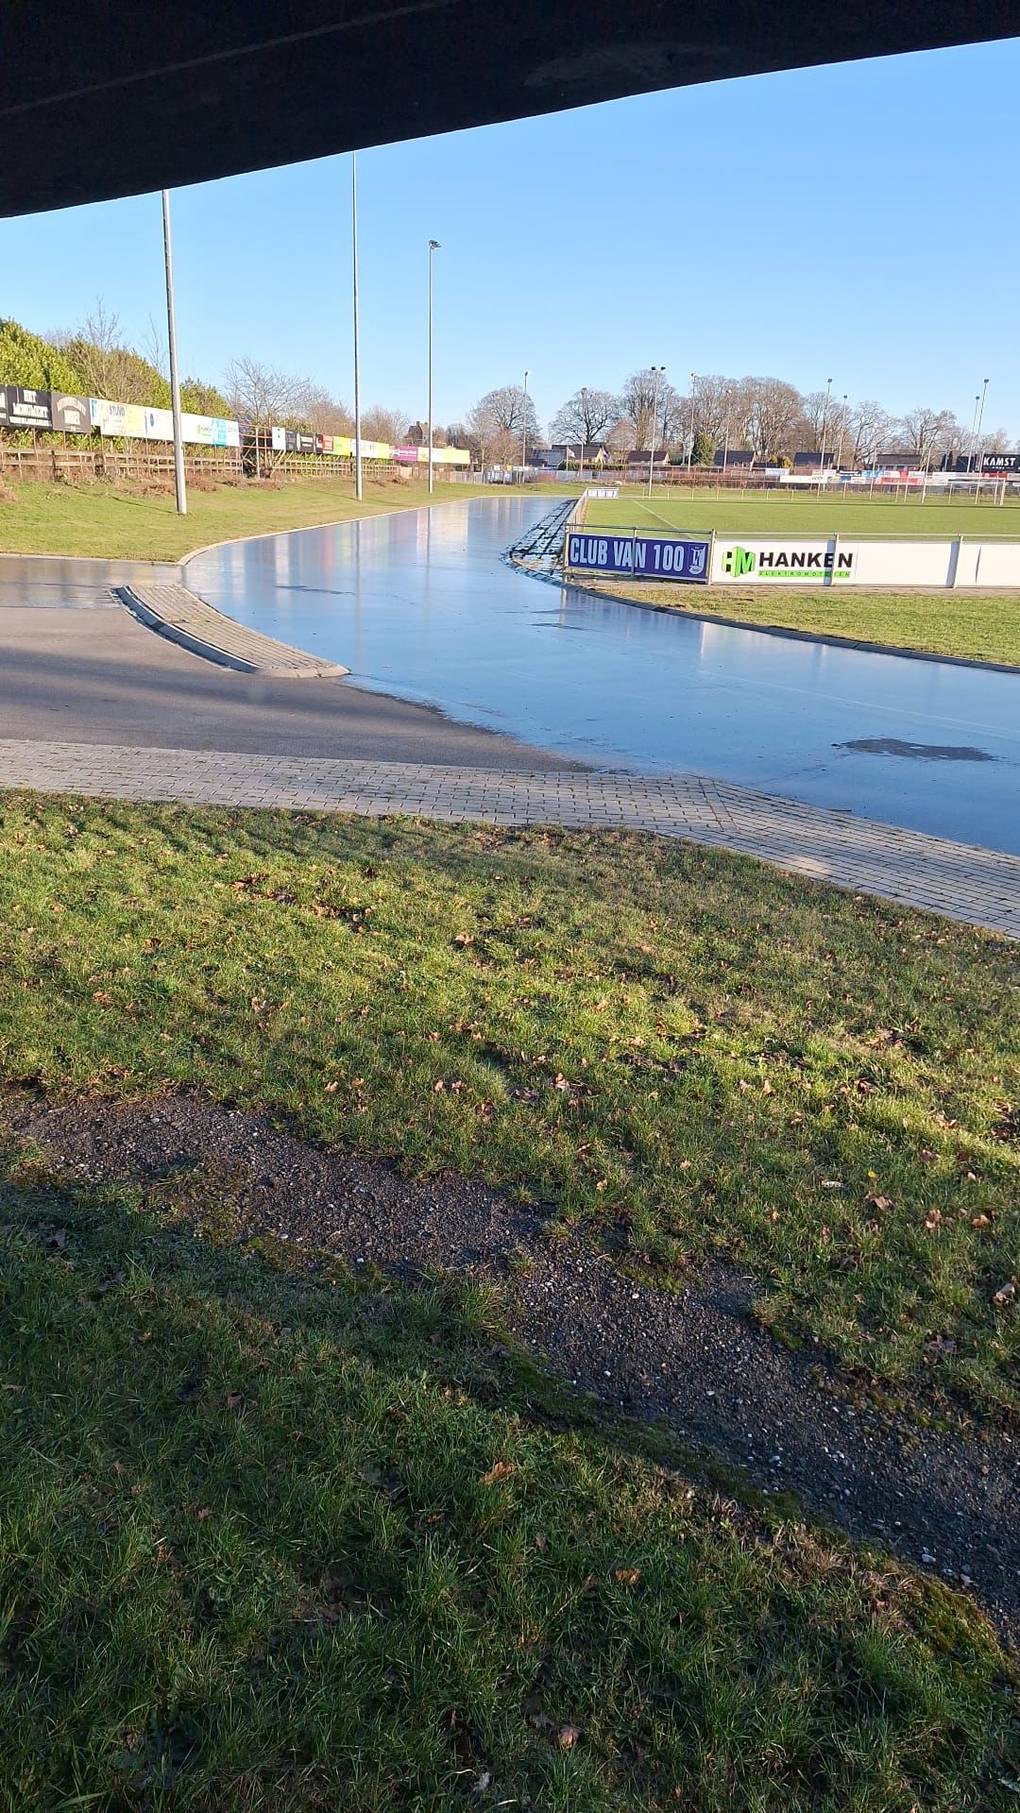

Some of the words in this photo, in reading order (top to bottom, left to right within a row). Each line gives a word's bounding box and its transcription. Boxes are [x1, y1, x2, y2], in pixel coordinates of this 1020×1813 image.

[983, 457, 1016, 466] KAMST
[569, 537, 609, 566] CLUB
[613, 540, 647, 569] VAN
[653, 544, 685, 572] 100
[759, 551, 854, 568] HANKEN
